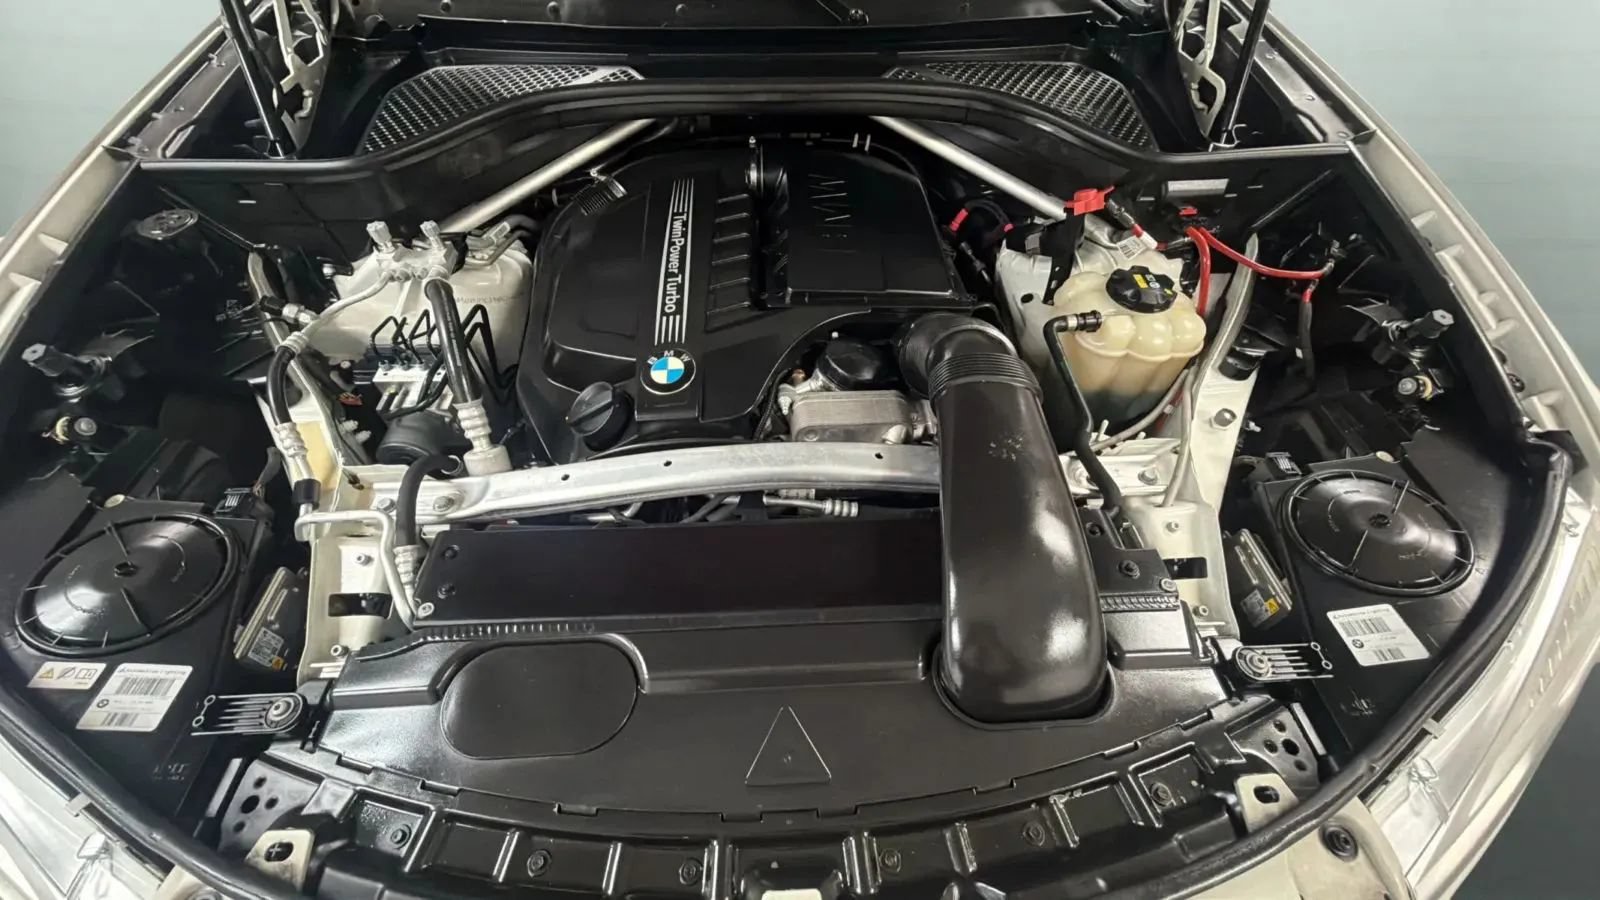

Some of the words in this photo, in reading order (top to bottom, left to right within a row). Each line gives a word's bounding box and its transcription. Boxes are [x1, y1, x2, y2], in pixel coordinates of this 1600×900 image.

[669, 214, 687, 273] TwinPower
[665, 274, 682, 313] Turbo
[647, 349, 691, 364] BMW
